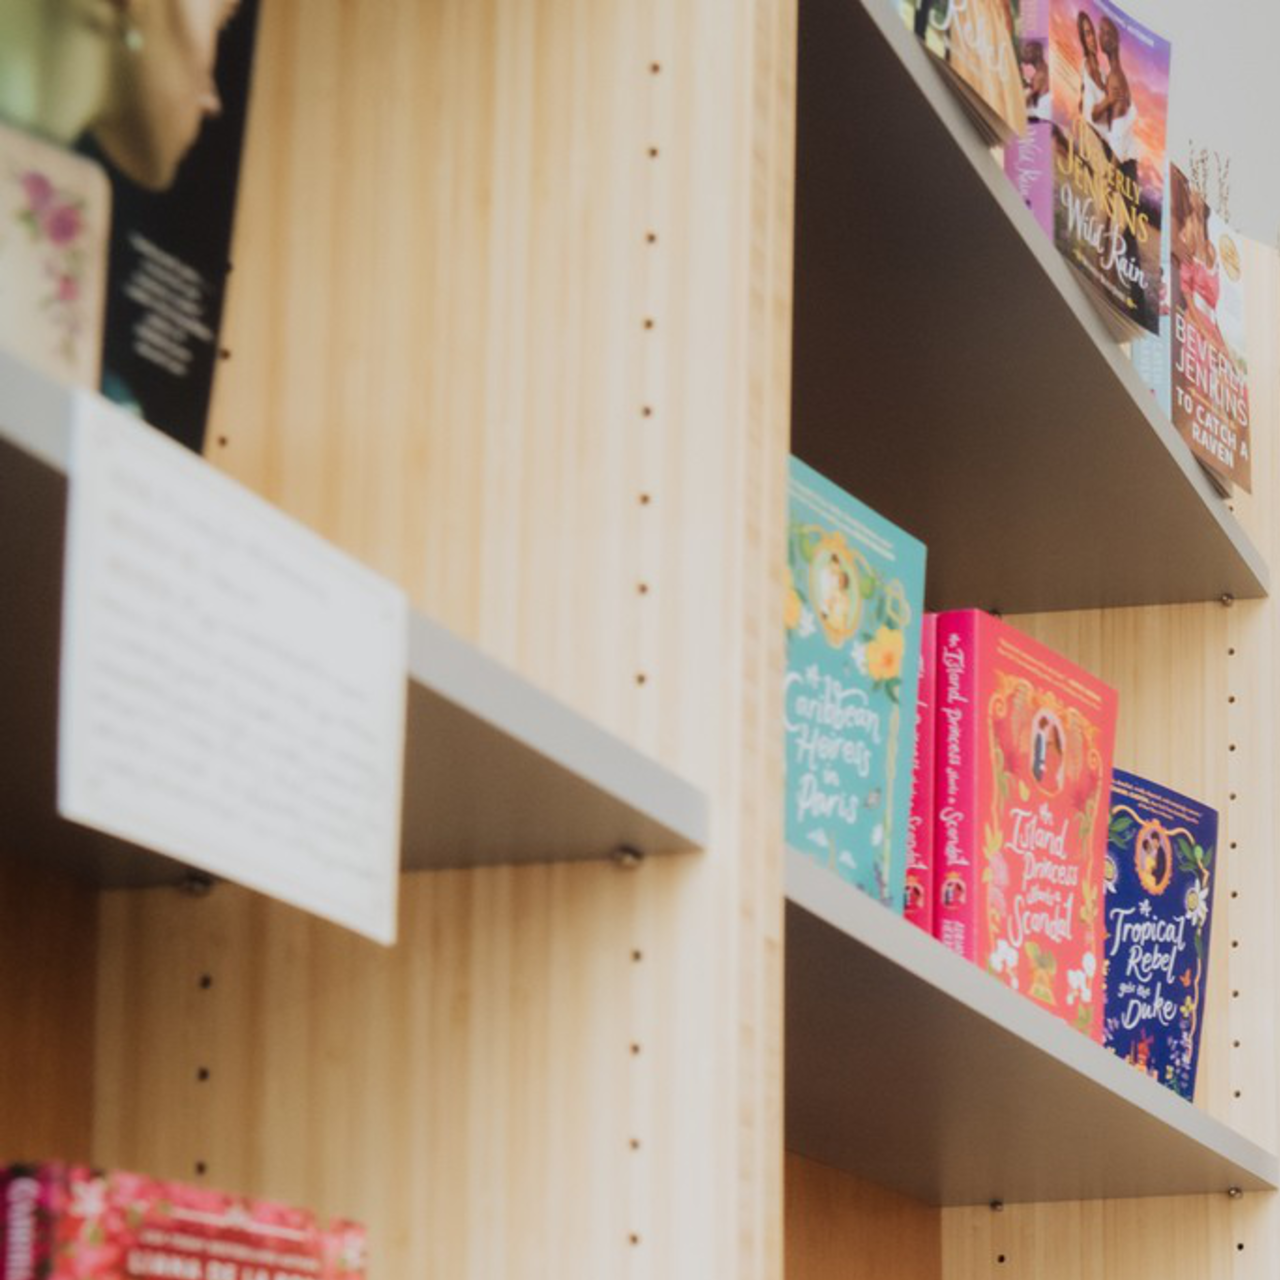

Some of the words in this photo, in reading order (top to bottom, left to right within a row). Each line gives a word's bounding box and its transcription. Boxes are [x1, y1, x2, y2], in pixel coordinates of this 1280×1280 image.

[1061, 182, 1106, 254] Wild
[1100, 225, 1149, 290] Rain
[1175, 312, 1249, 397] BEVERLY
[1176, 346, 1248, 427] JENKINS
[1176, 386, 1194, 414] TO
[1195, 405, 1237, 450] CATCH
[1240, 440, 1248, 461] A
[1191, 421, 1235, 469] RAVEN
[796, 772, 859, 824] Paris
[1004, 808, 1070, 861] Island
[1007, 892, 1074, 949] Scandal
[1109, 907, 1186, 956] Tropical
[1125, 944, 1175, 984] Rebel
[1121, 981, 1177, 1030] Duke
